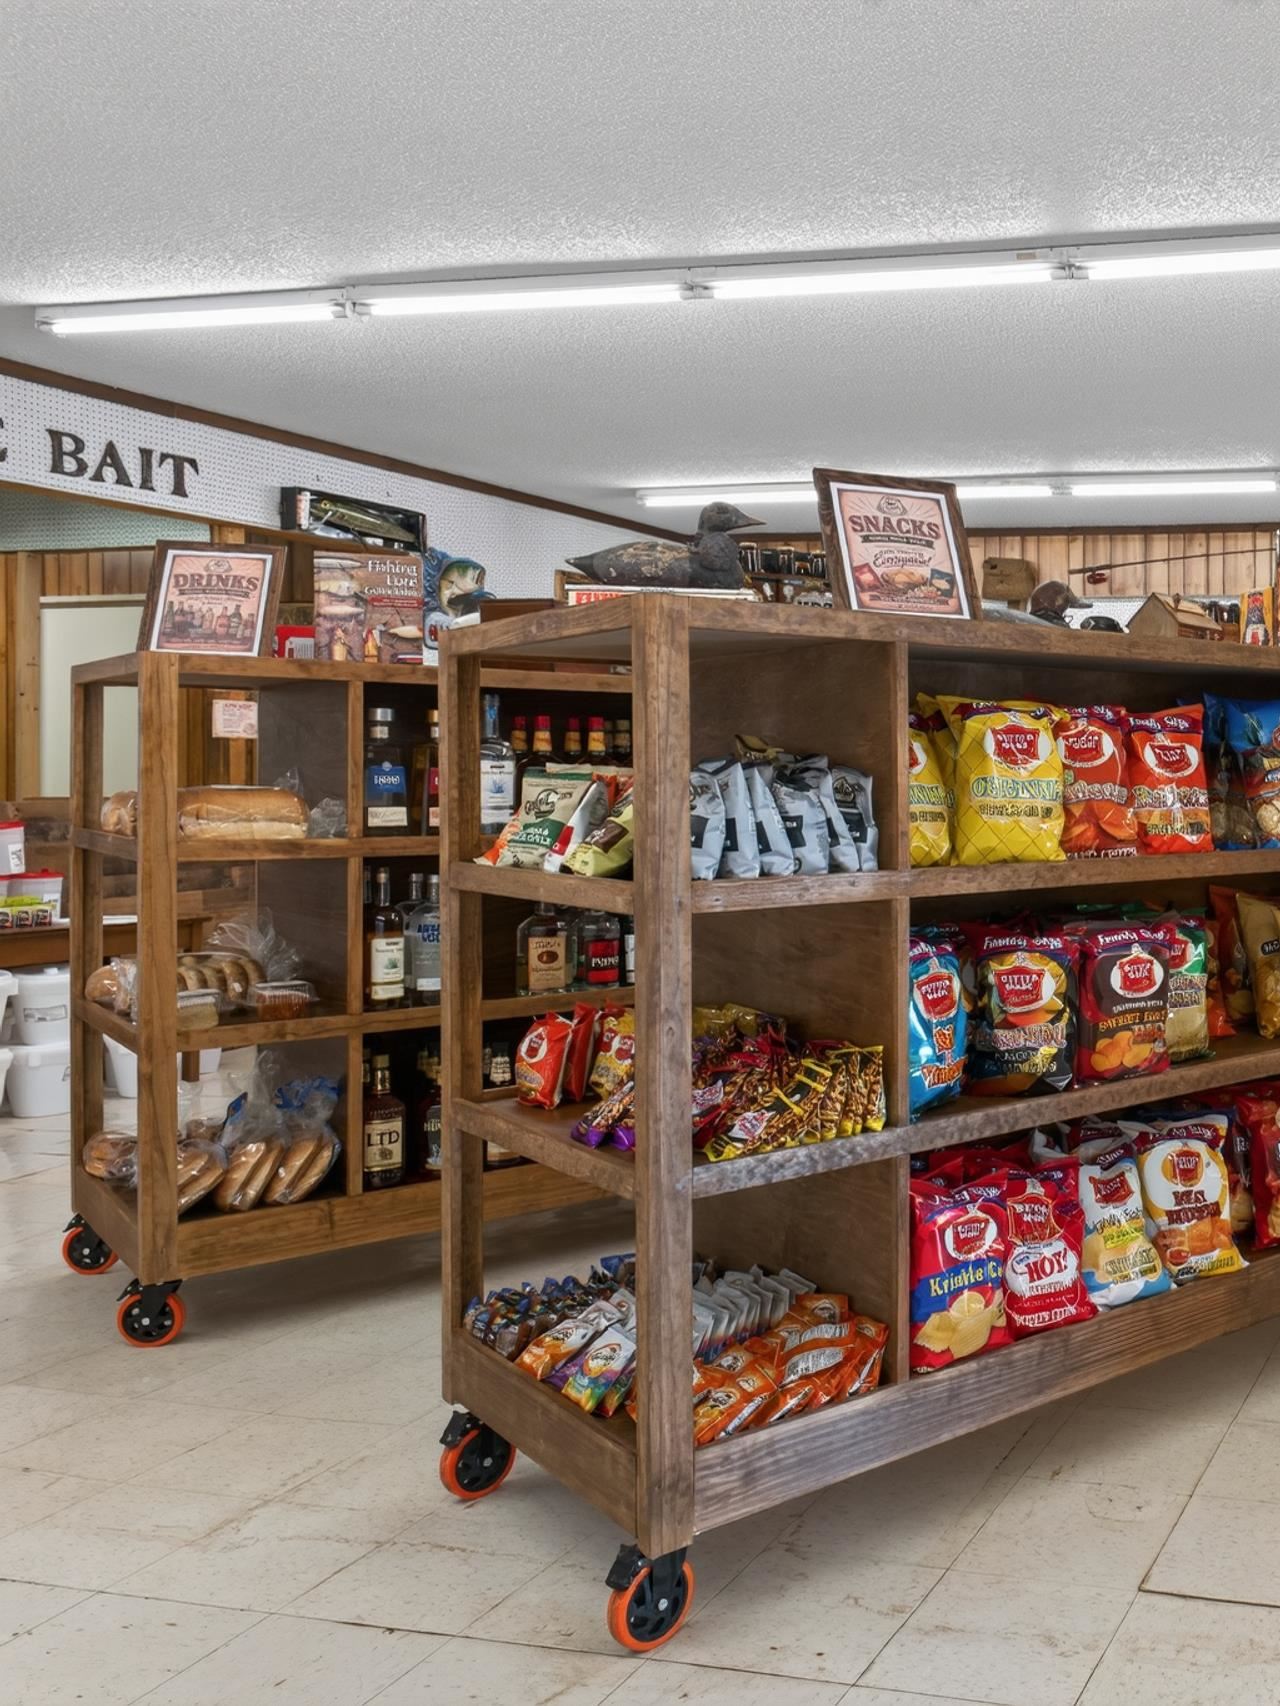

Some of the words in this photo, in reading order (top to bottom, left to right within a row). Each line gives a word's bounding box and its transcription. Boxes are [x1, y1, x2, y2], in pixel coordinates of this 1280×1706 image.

[46, 429, 199, 498] BAIT
[849, 515, 941, 540] SNACKS
[173, 573, 259, 591] DRINKS
[367, 1130, 400, 1147] LTD
